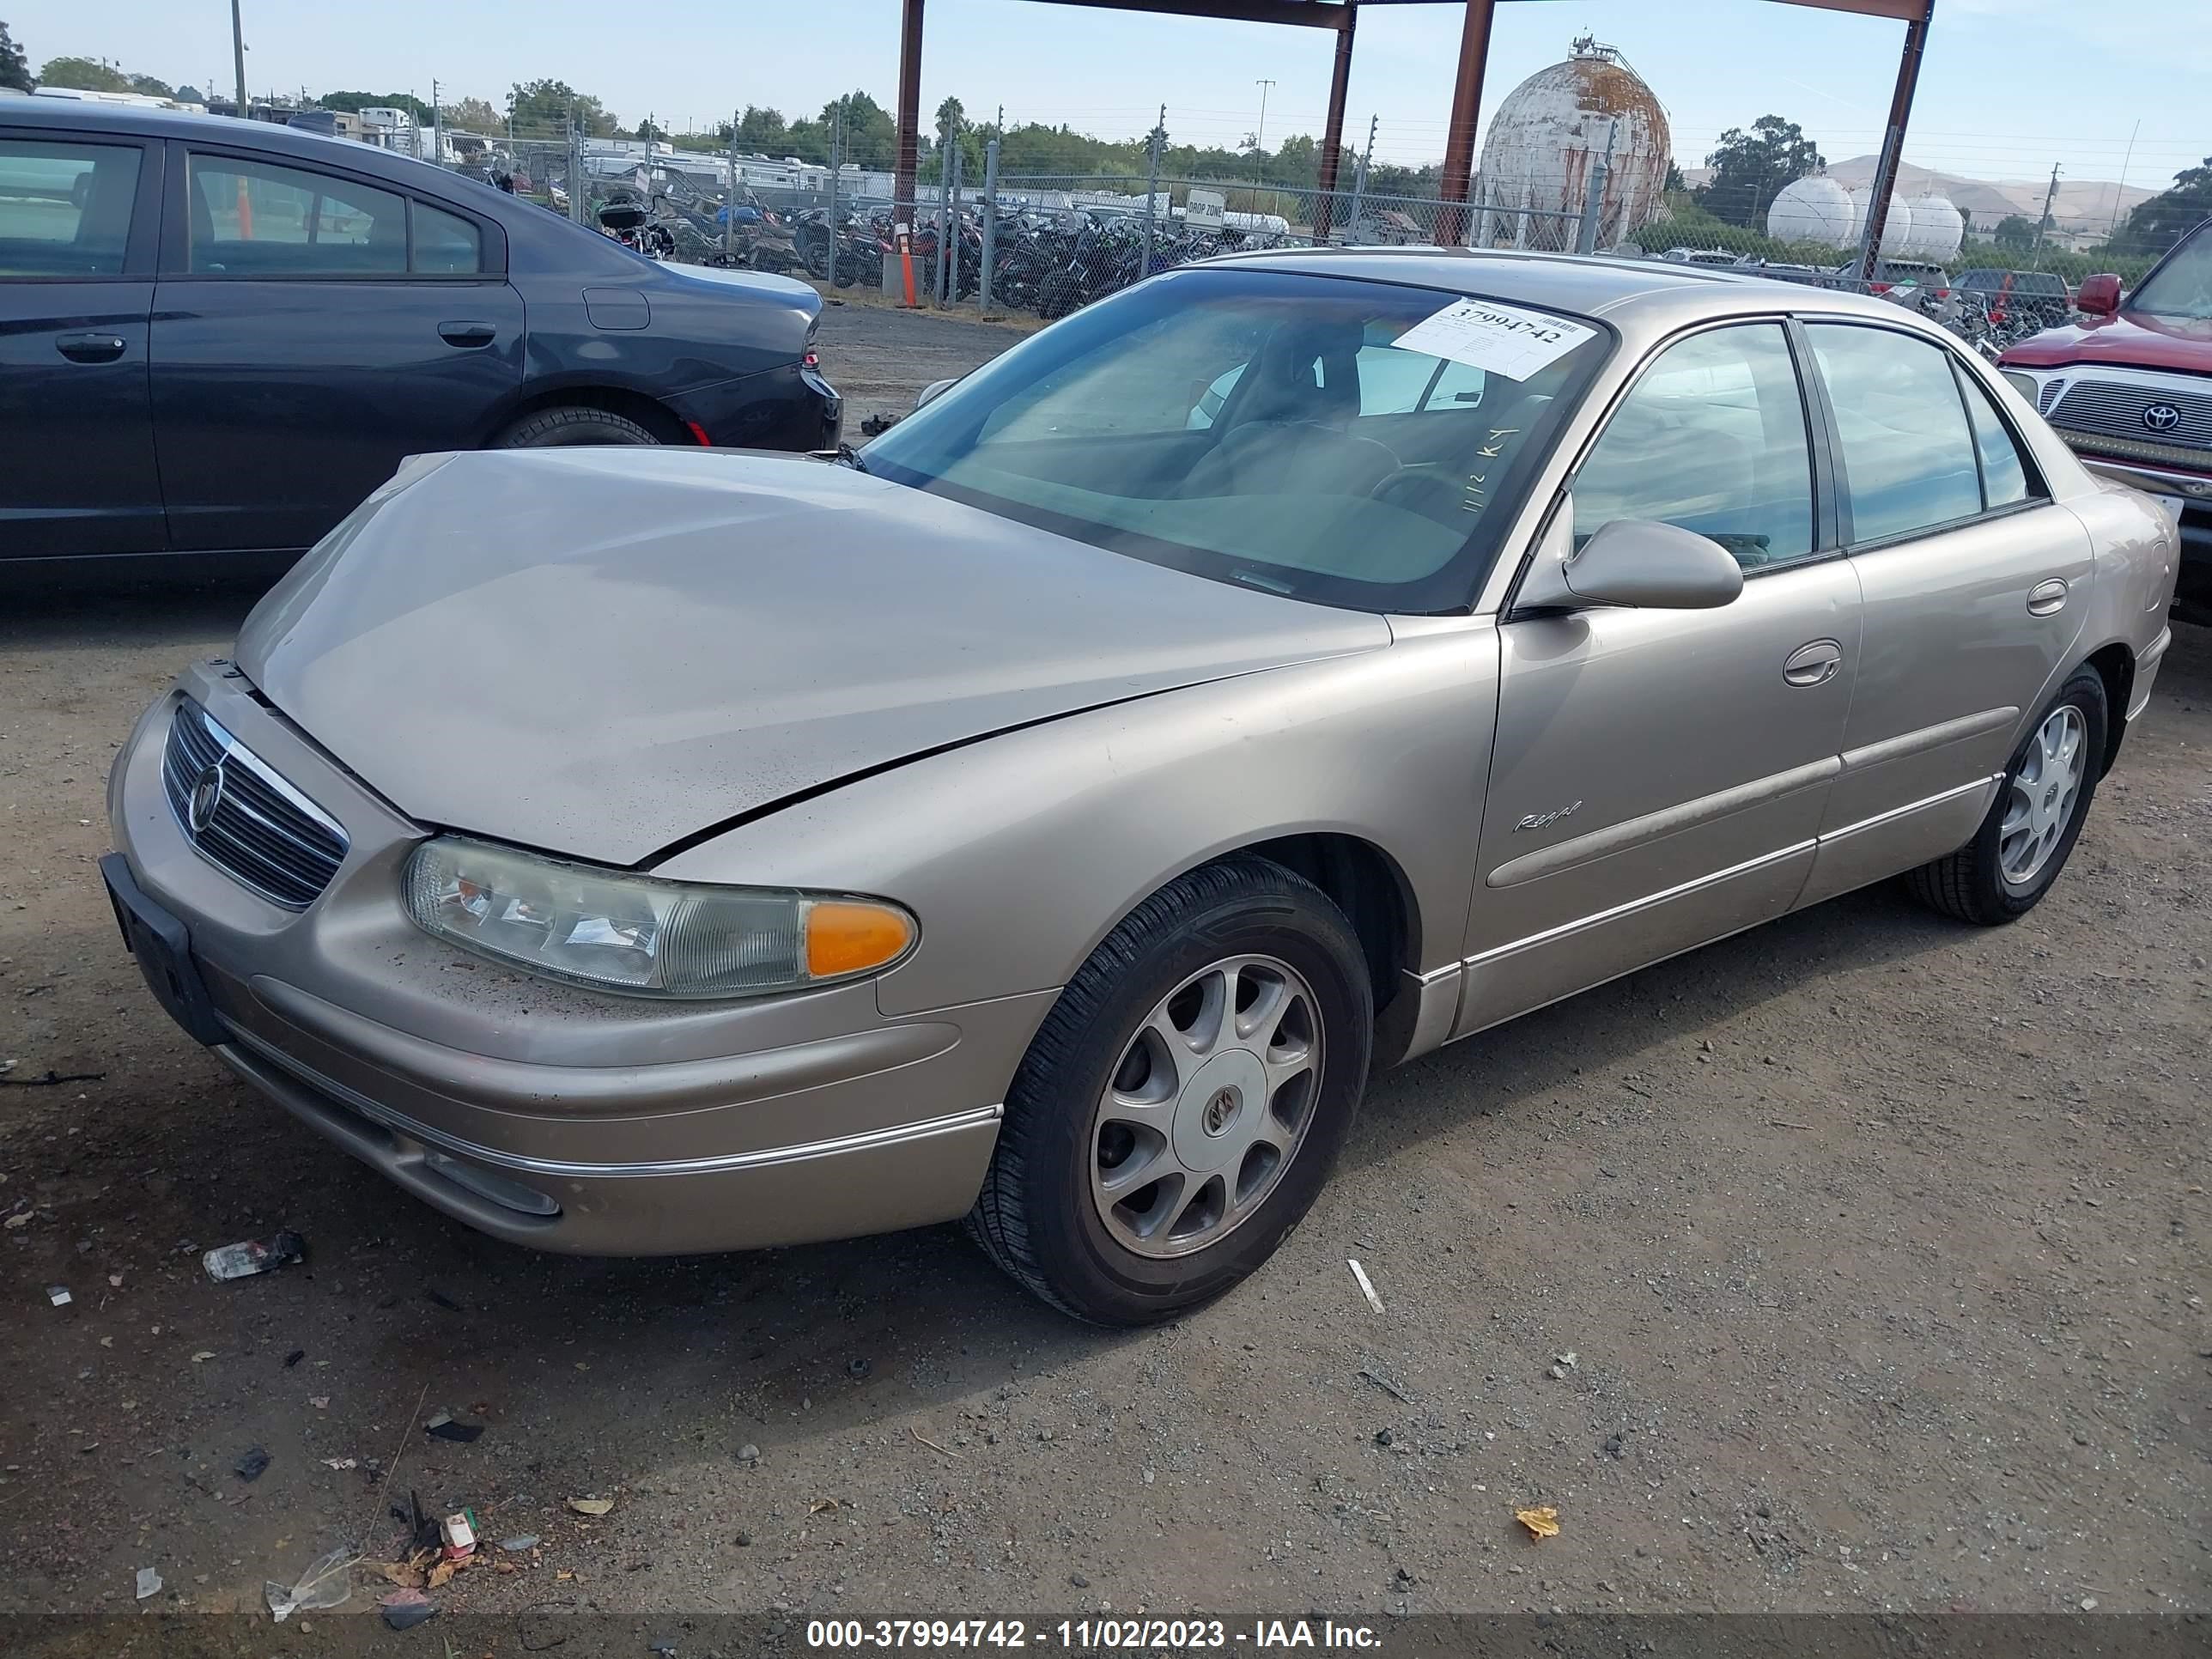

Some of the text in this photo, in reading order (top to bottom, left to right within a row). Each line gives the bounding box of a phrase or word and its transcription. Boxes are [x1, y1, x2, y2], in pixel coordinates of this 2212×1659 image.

[1189, 202, 1223, 217] DROP ZONE
[1451, 308, 1562, 343] 37994742
[1476, 427, 1520, 457] KY
[1514, 800, 1583, 832] Regal
